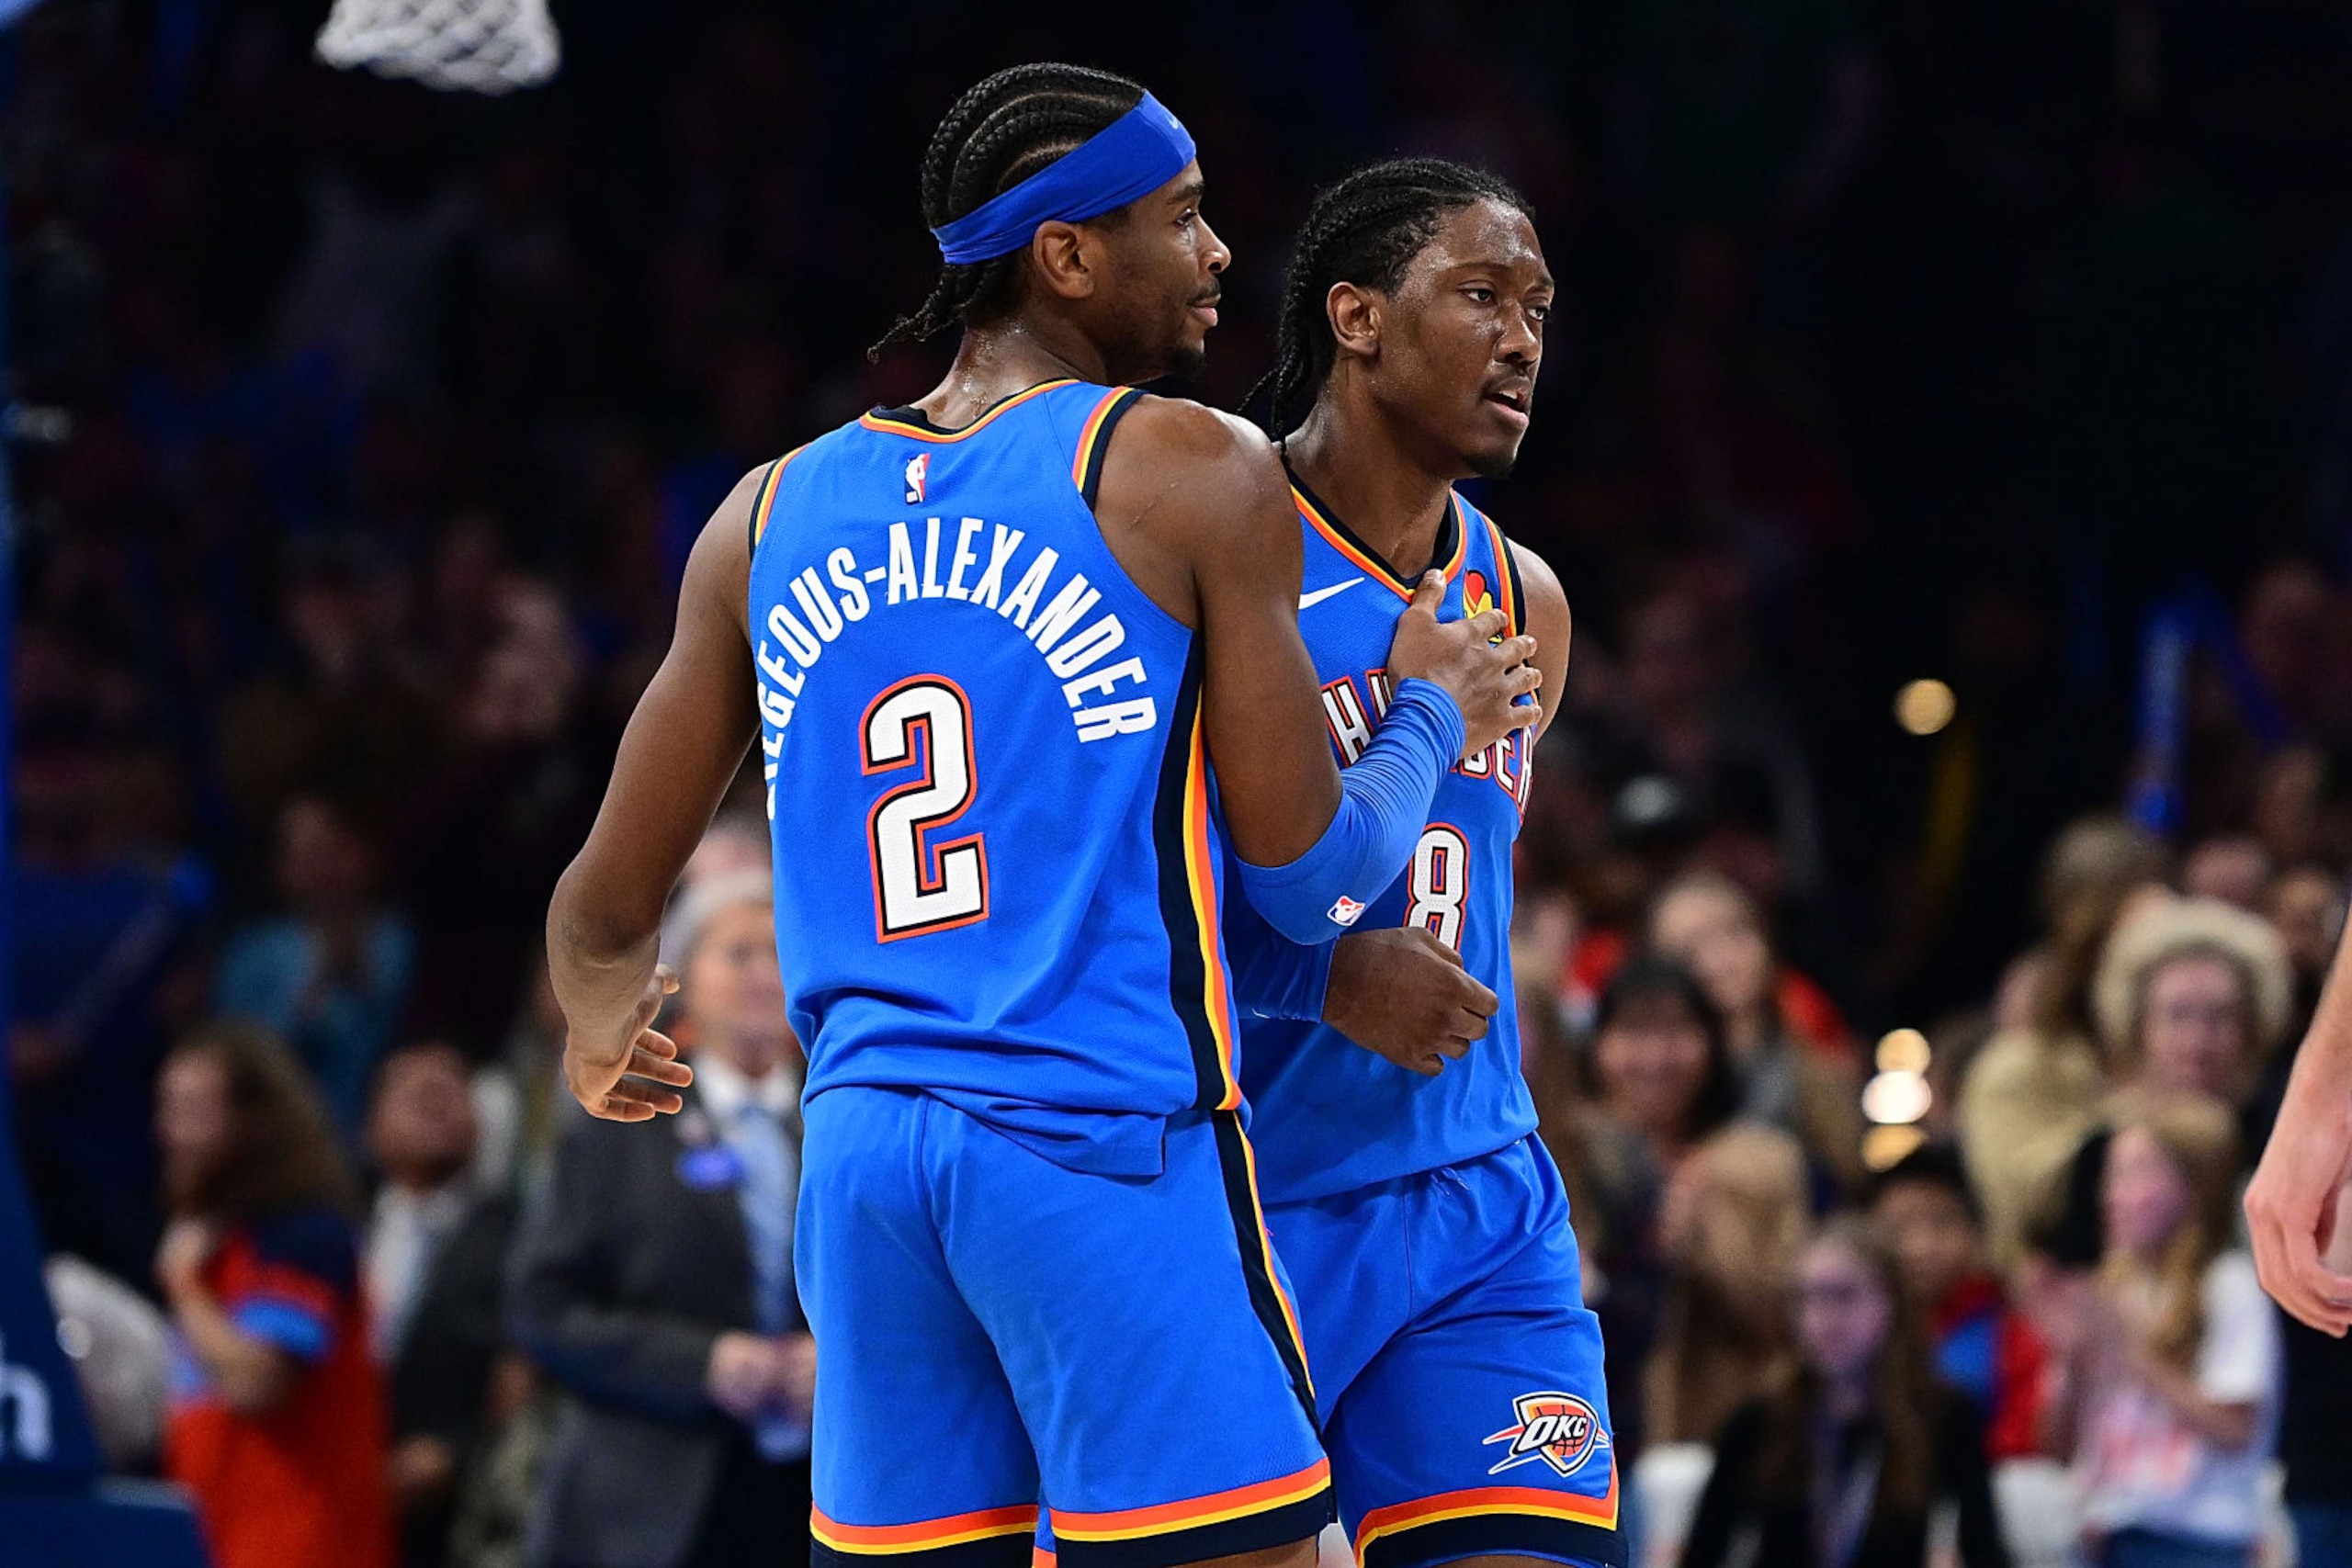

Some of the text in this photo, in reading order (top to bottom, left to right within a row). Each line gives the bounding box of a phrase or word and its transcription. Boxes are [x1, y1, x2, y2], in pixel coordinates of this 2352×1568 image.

[758, 517, 1157, 821] GEOUS-ALEXANDER
[858, 673, 990, 944] 2
[1402, 821, 1470, 953] 8
[1513, 1414, 1589, 1453] OKC
